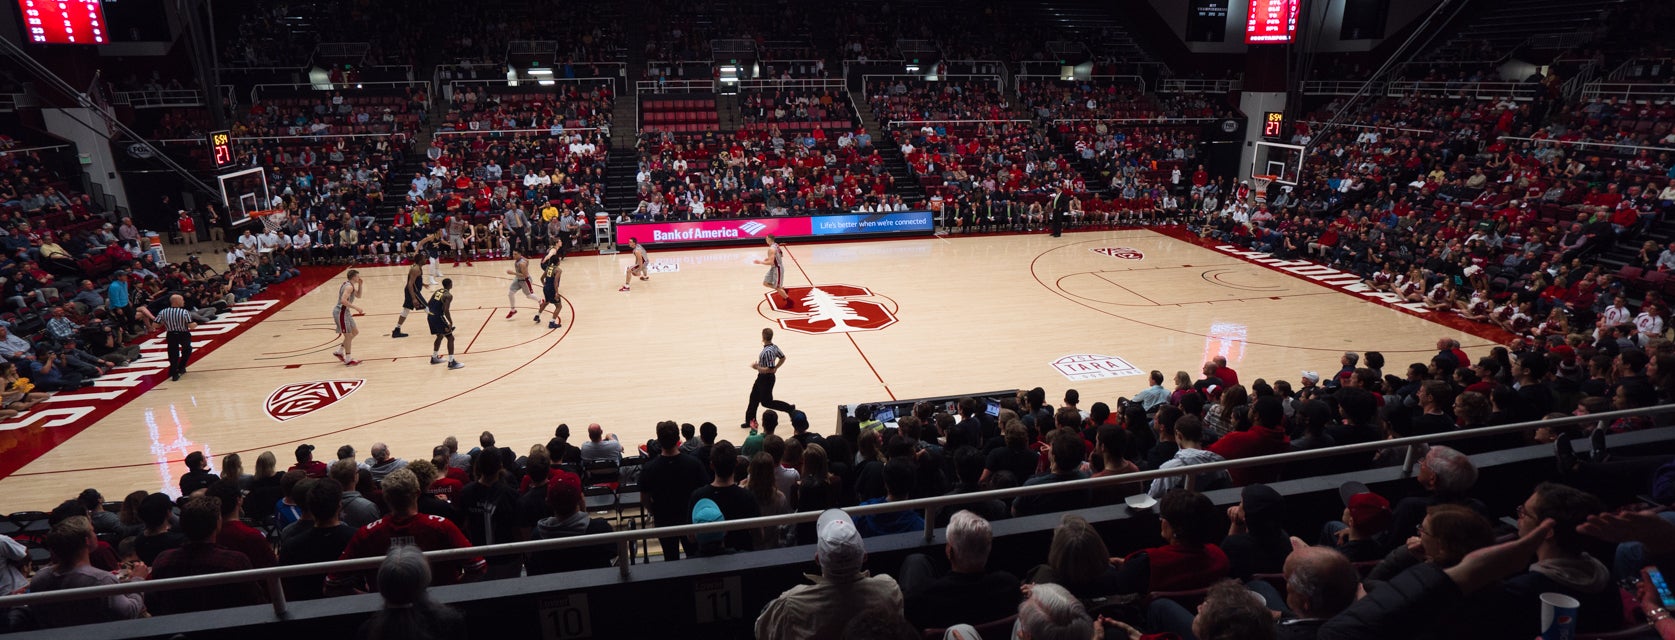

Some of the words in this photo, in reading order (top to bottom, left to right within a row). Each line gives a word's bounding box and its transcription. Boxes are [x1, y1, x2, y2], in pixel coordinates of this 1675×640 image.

[1269, 113, 1282, 121] 6:54
[1266, 121, 1279, 135] 27
[214, 134, 228, 145] 6:54
[215, 145, 230, 164] 27
[859, 220, 876, 228] when
[894, 217, 927, 226] connected
[653, 229, 681, 241] Bank
[684, 228, 695, 239] of
[695, 226, 738, 239] America
[1064, 360, 1119, 371] TARA
[278, 400, 320, 414] 12
[707, 591, 732, 619] 11
[547, 607, 584, 637] 10
